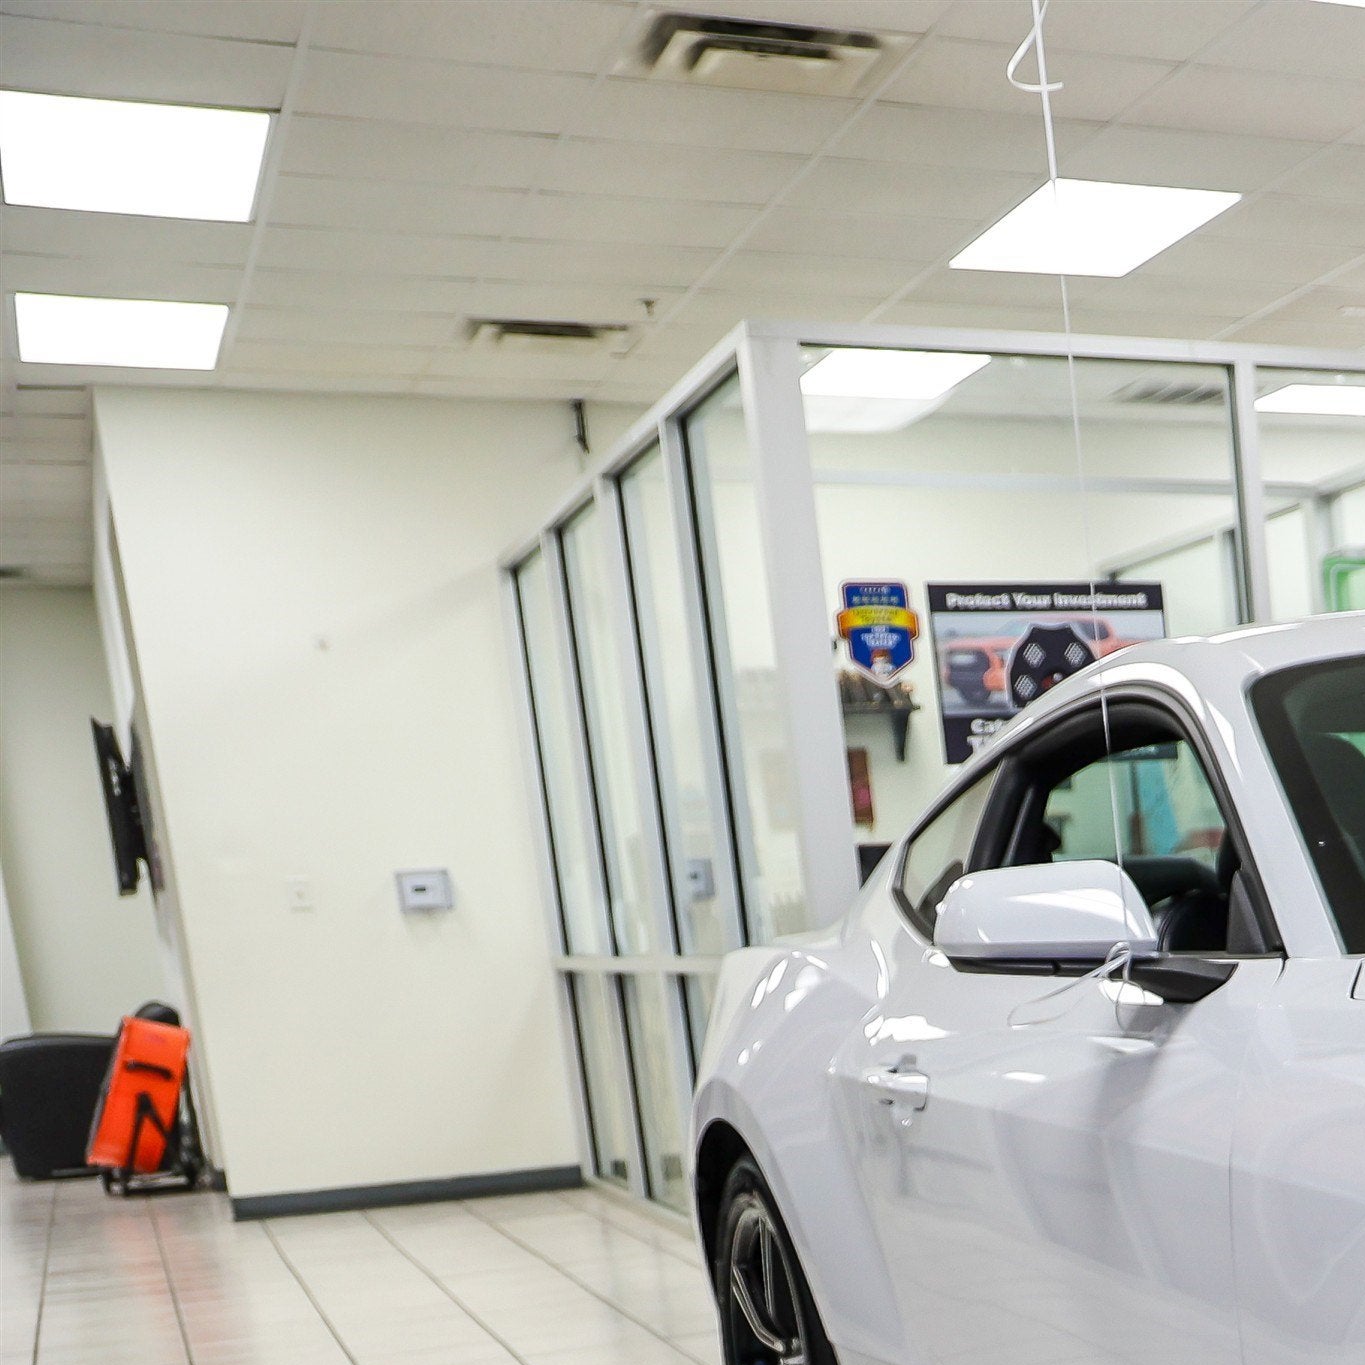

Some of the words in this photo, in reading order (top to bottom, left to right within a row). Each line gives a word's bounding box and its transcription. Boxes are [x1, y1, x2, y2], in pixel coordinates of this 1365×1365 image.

[946, 592, 1011, 609] Protect
[1011, 592, 1051, 609] Your
[1053, 592, 1148, 609] Investment
